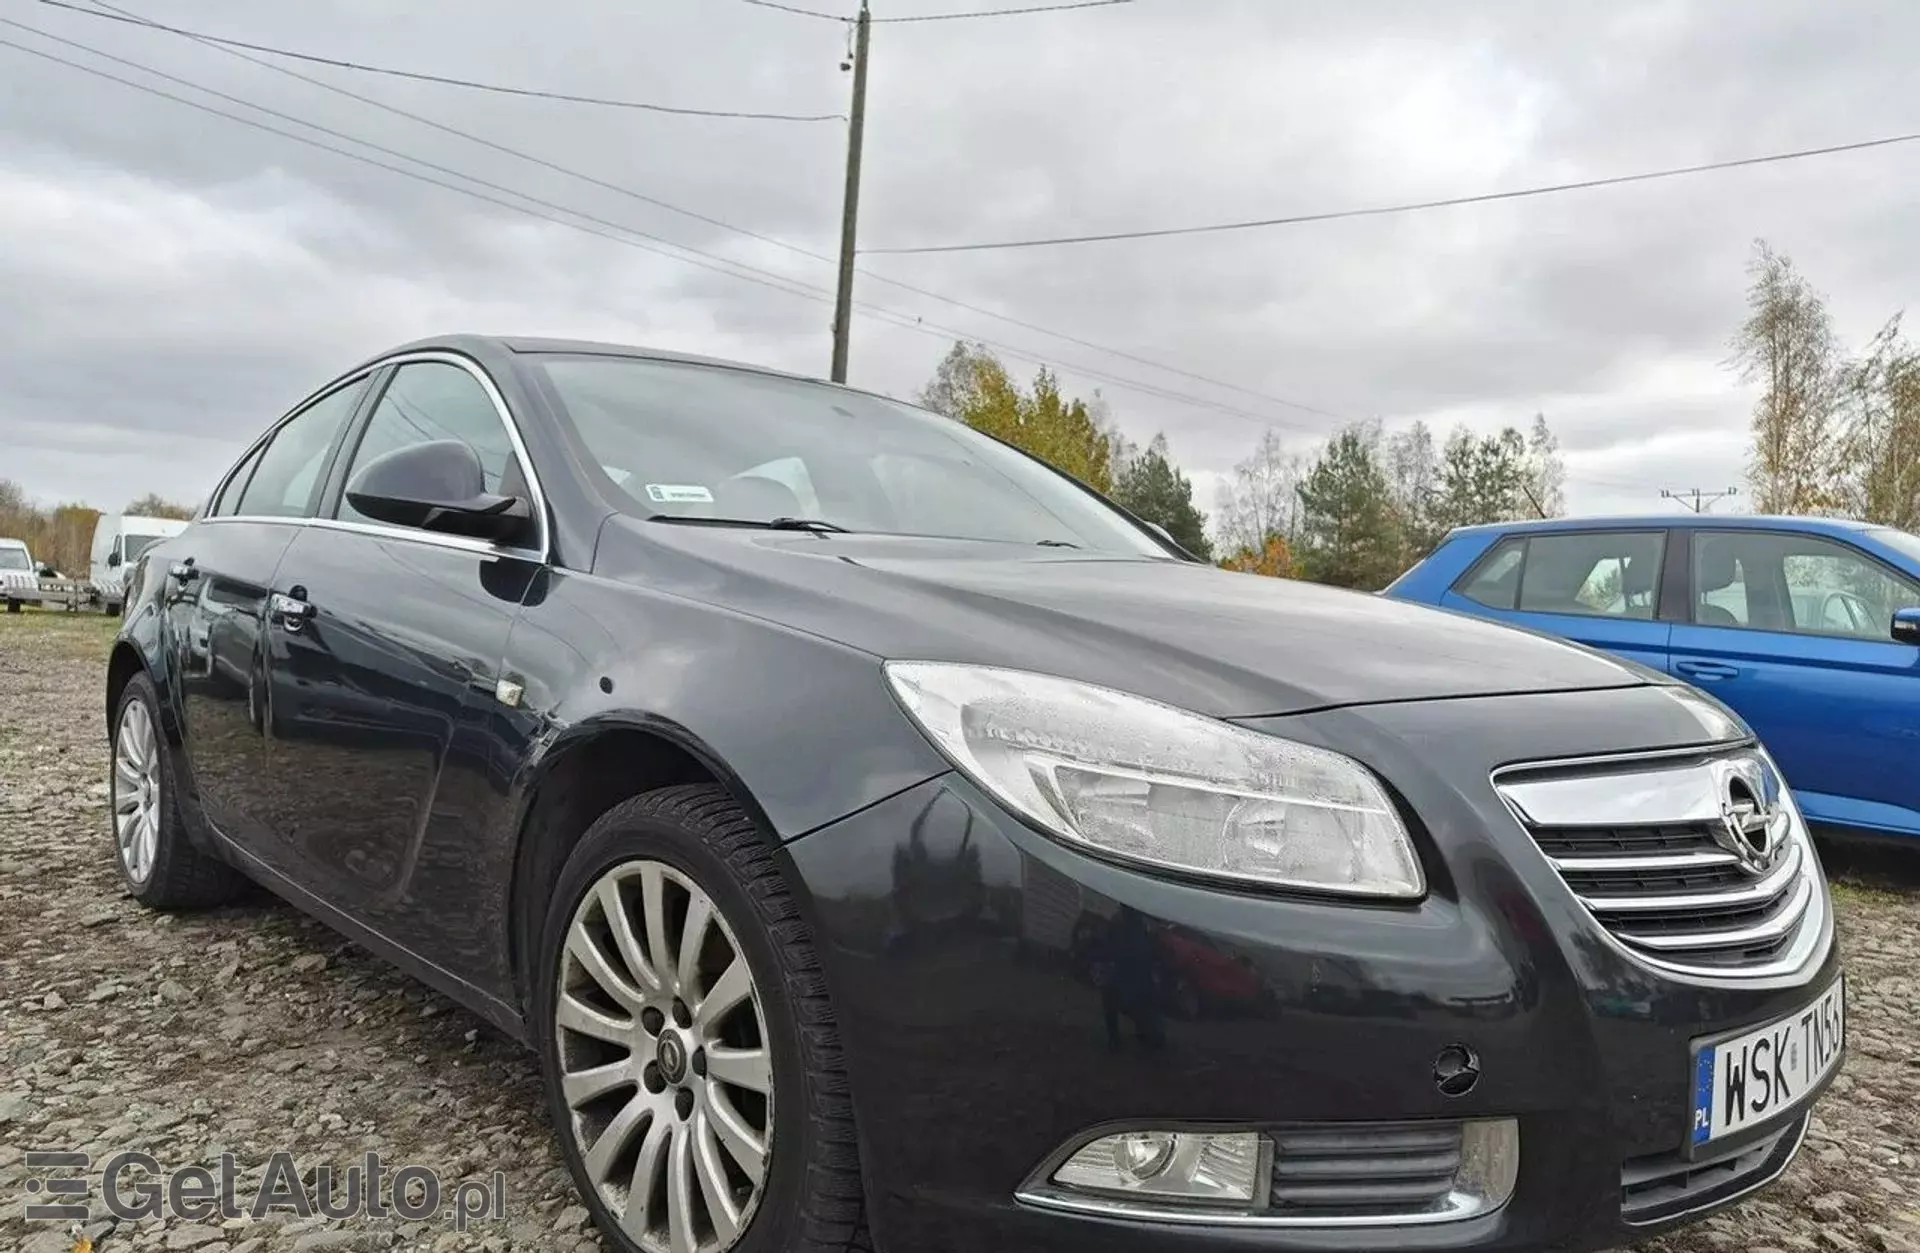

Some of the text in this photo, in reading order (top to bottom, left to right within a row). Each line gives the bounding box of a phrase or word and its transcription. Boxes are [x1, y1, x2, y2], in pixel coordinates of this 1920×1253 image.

[1725, 992, 1839, 1127] WSK TN56
[1694, 1107, 1709, 1131] PL
